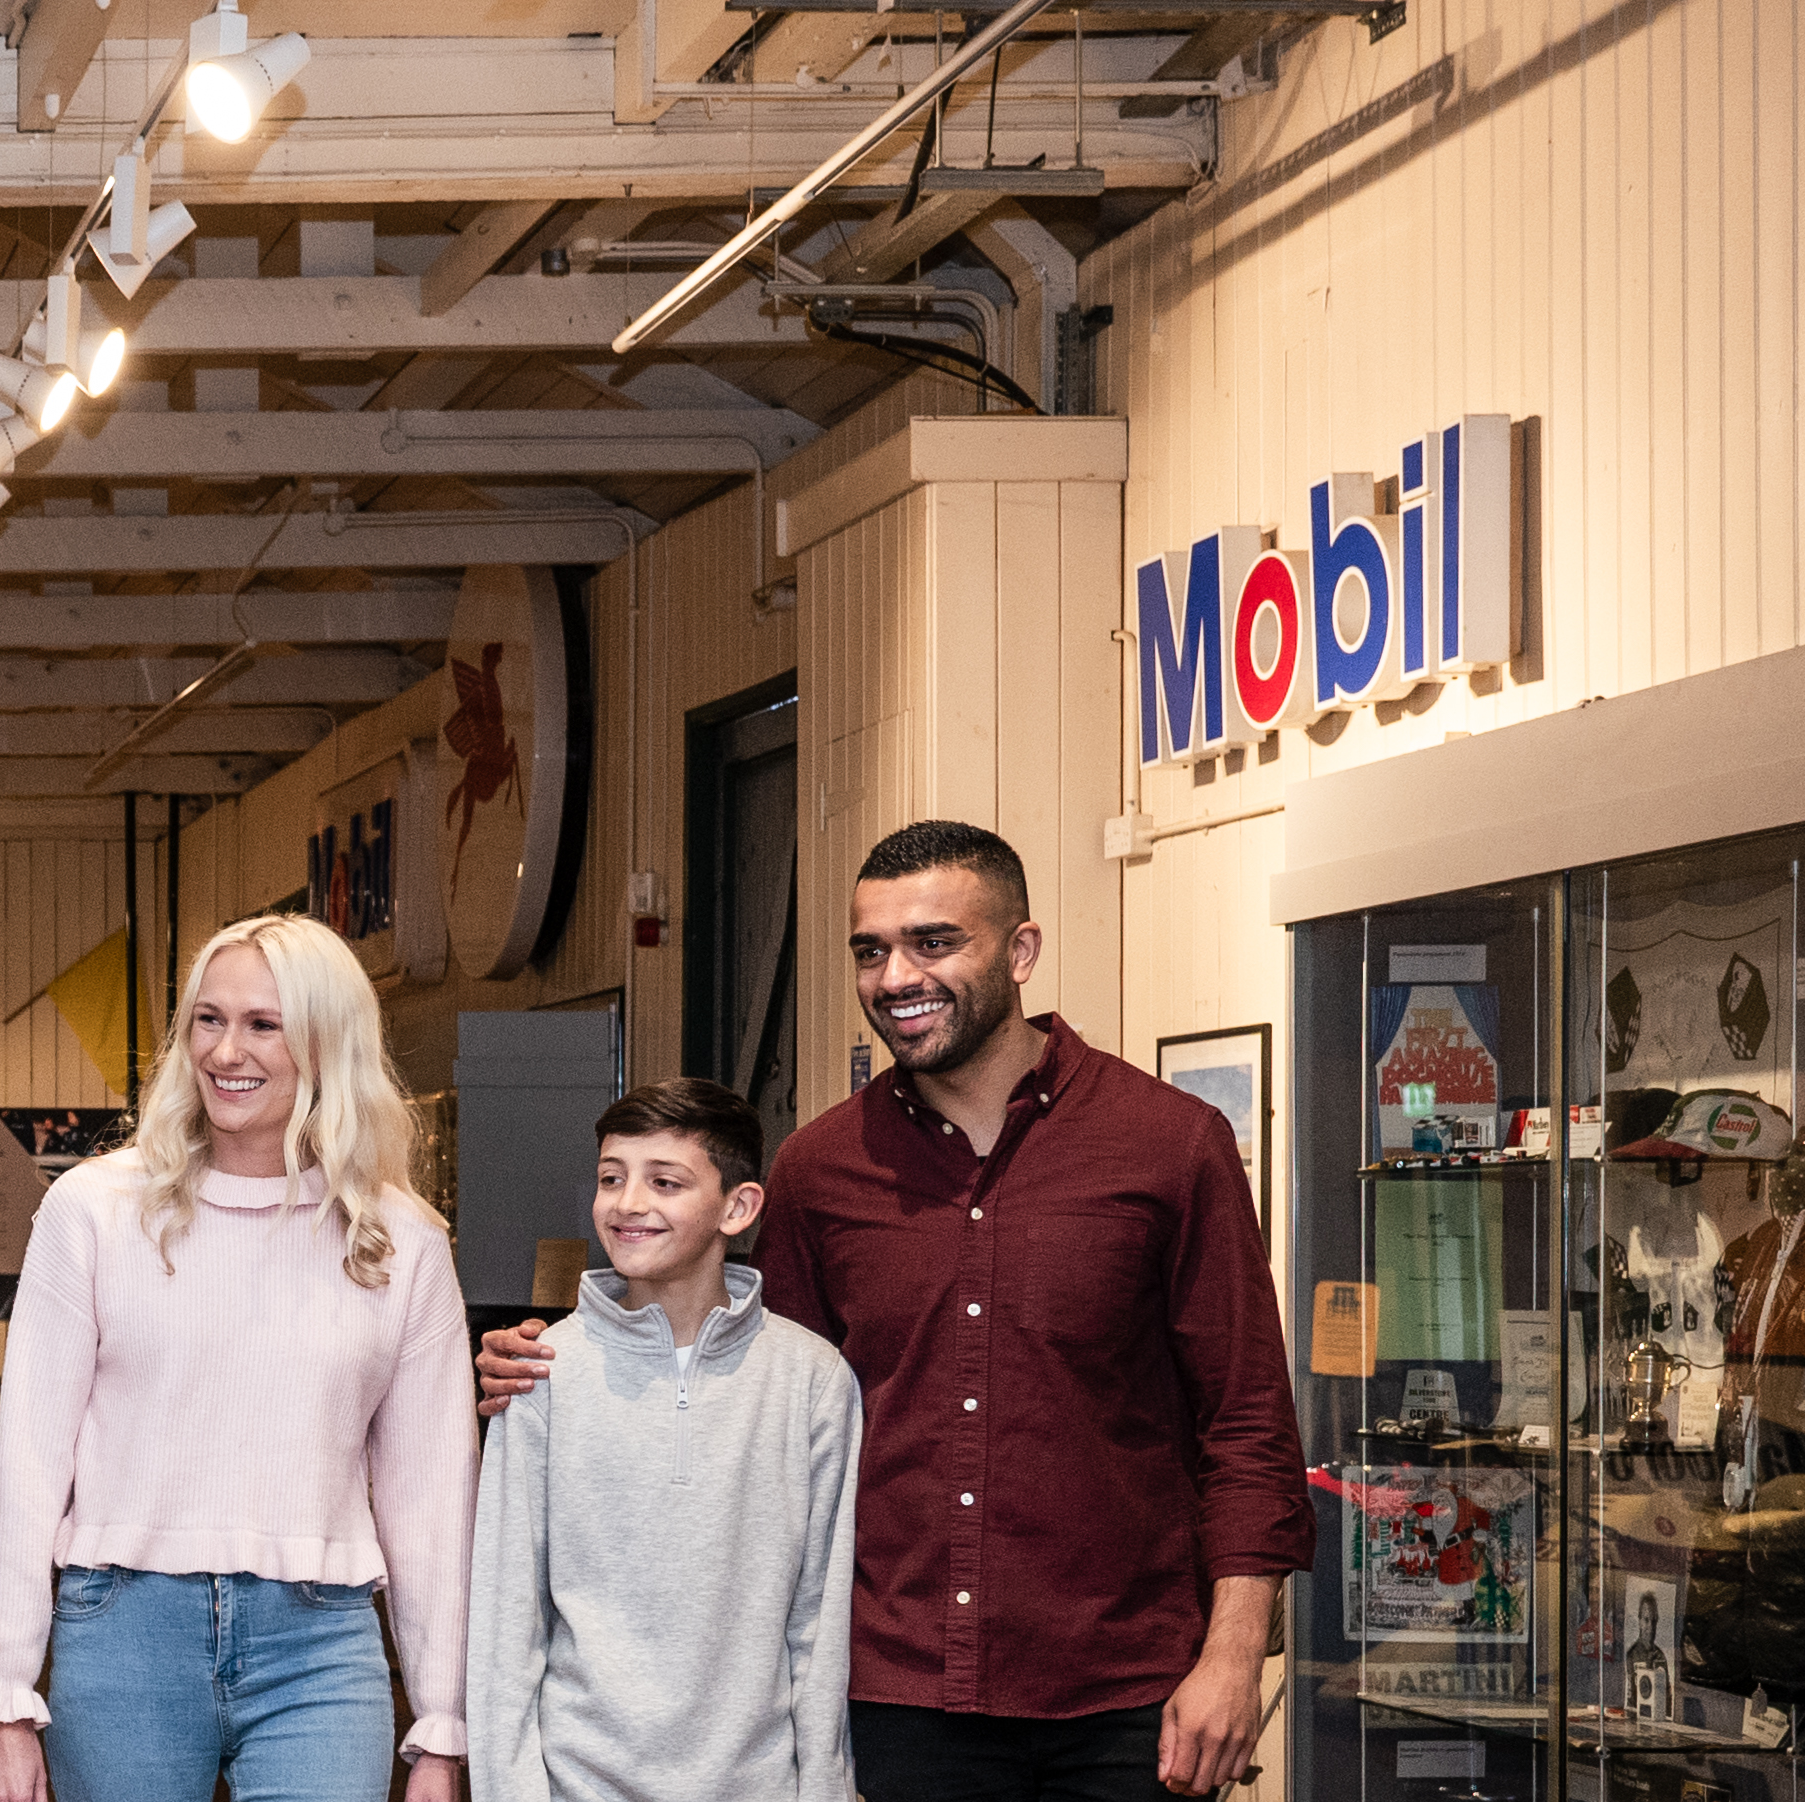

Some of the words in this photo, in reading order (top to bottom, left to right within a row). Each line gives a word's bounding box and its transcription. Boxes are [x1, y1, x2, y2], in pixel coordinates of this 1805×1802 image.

[1135, 419, 1463, 772] Mobil
[1715, 1111, 1758, 1139] Castrol
[1366, 1669, 1510, 1694] MARTINI
